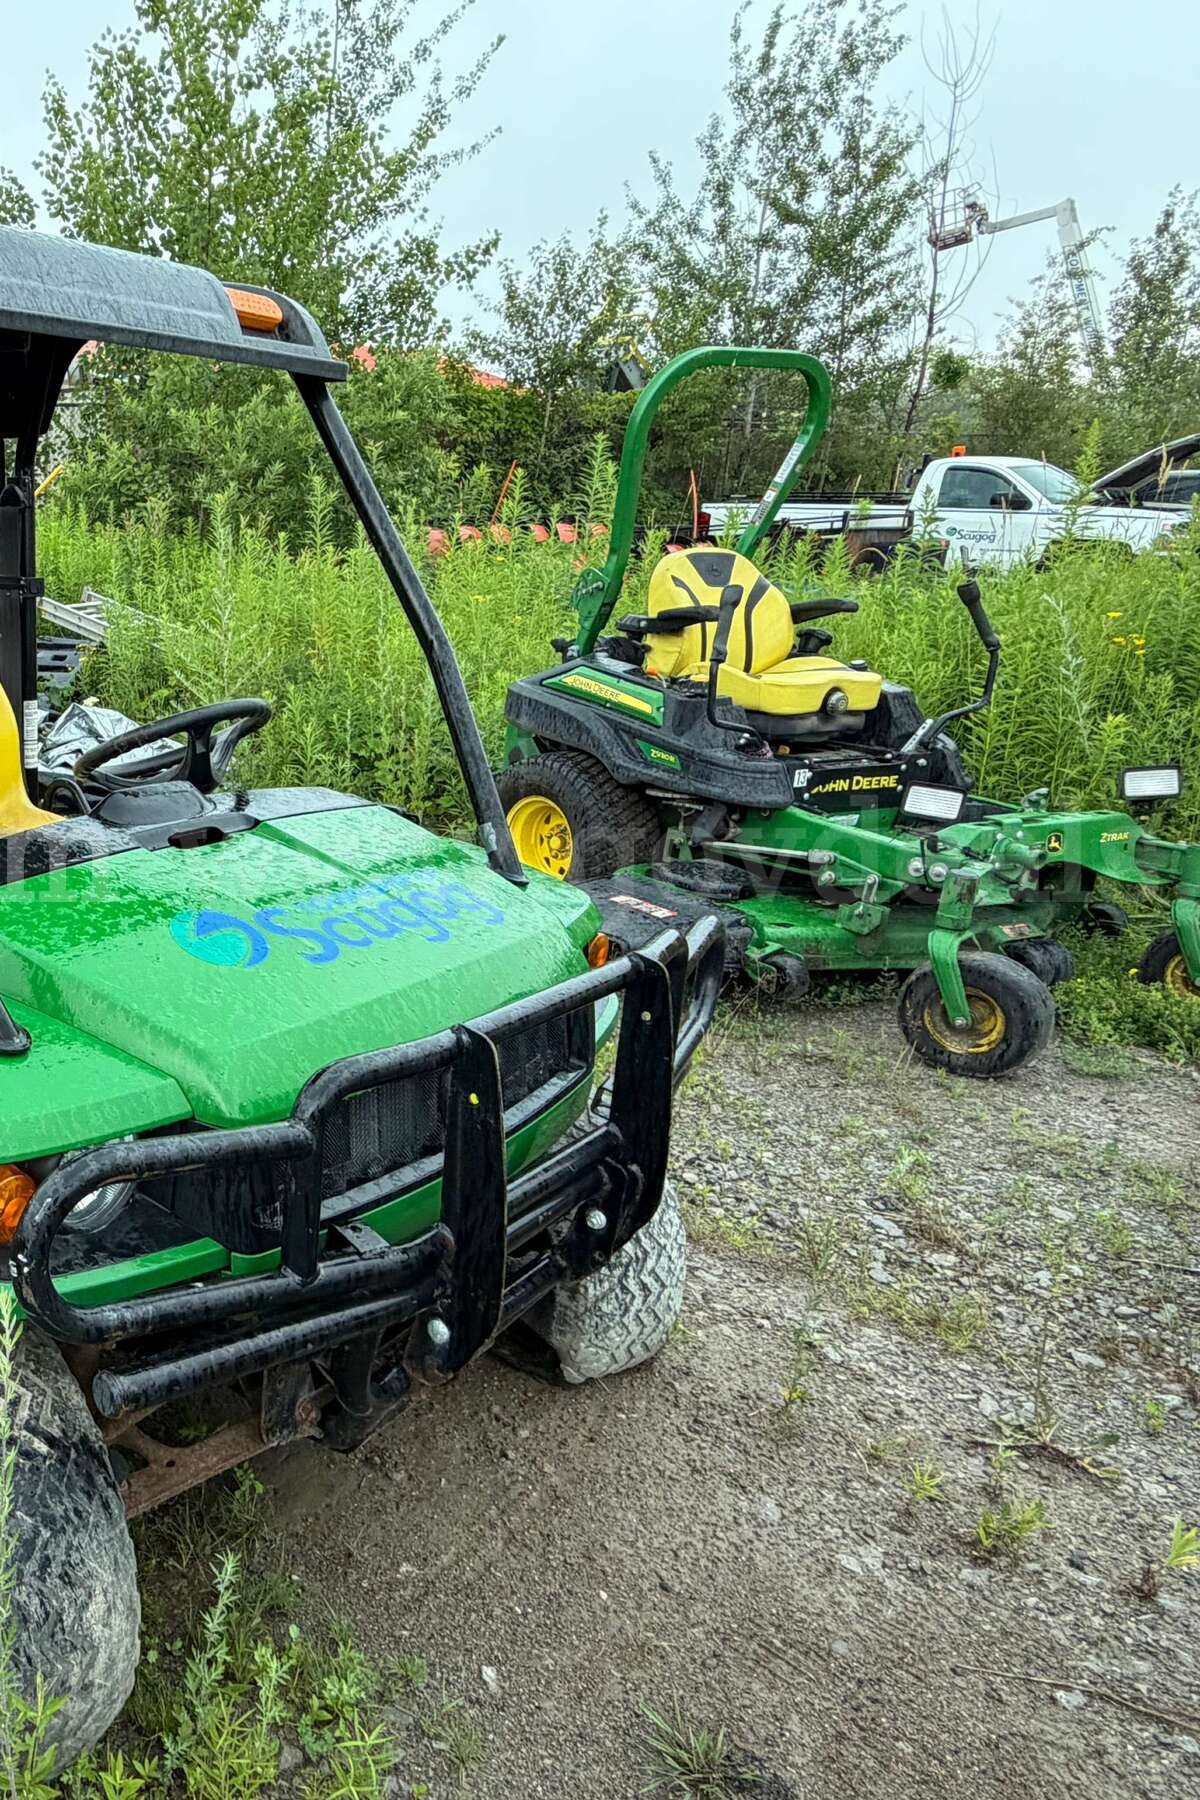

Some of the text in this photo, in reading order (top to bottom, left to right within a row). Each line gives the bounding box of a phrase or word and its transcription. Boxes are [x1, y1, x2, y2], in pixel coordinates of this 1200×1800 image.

[956, 529, 997, 543] Scugog
[571, 677, 620, 700] JOHN DEERE
[851, 775, 899, 791] DEERE
[1099, 831, 1130, 843] ZTRAK
[255, 882, 505, 965] Scugog
